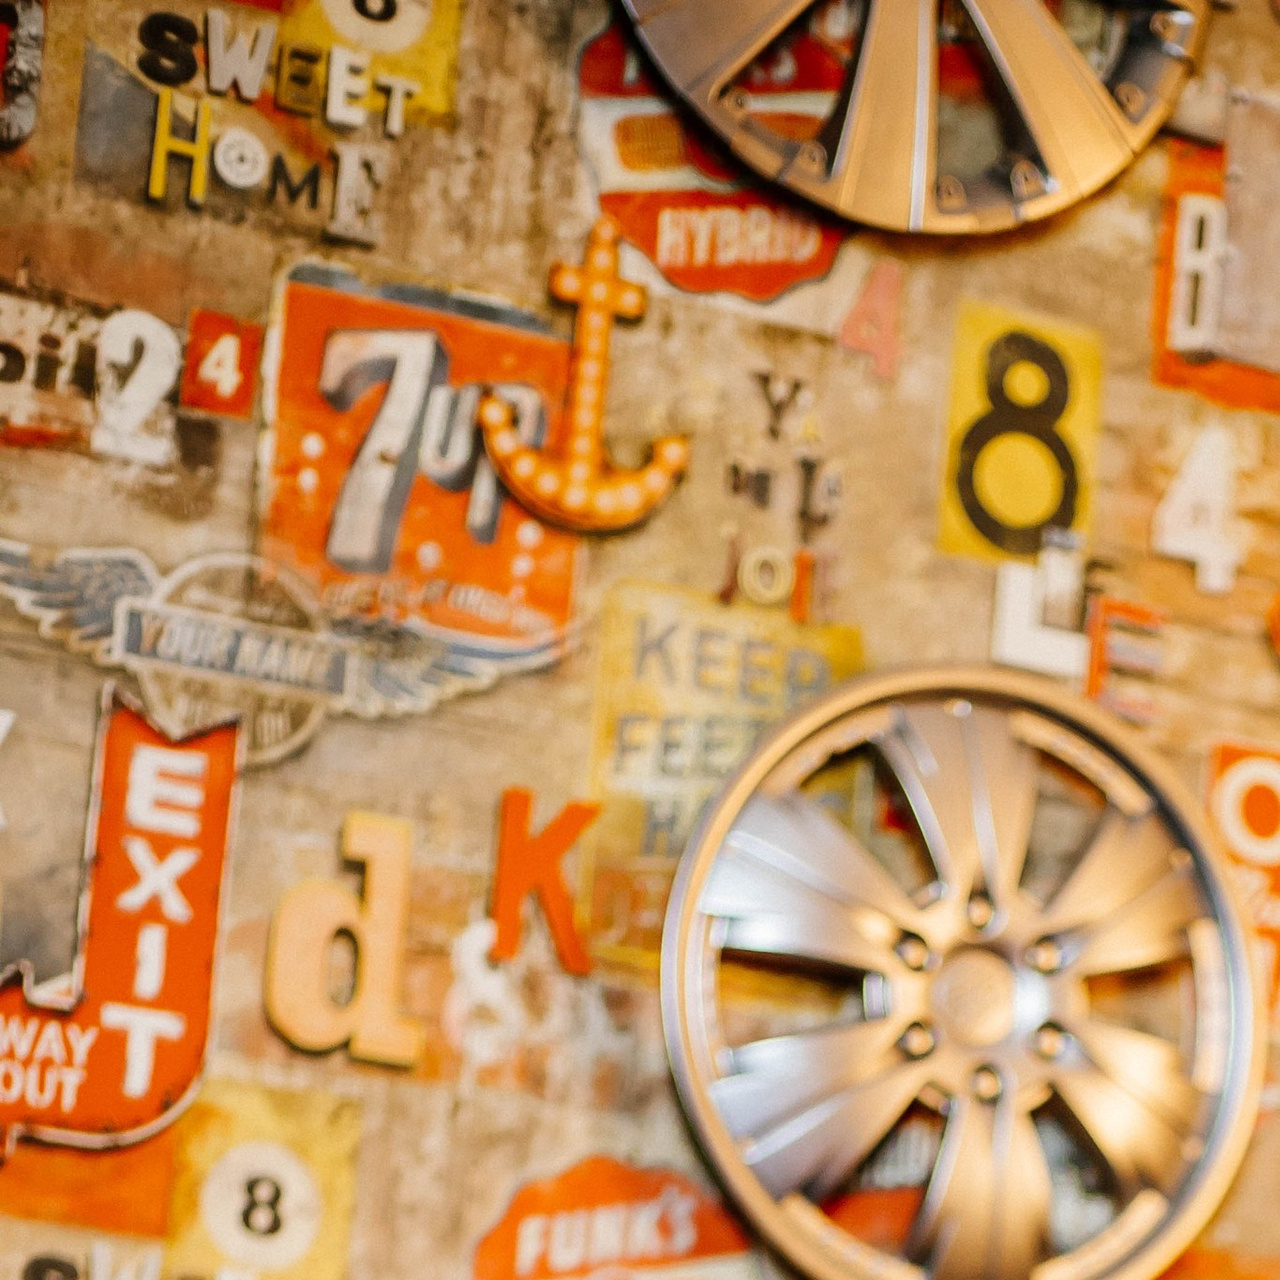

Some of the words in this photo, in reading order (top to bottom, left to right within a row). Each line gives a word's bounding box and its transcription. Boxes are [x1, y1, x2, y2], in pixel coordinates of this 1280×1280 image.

[137, 10, 421, 137] SWEET
[150, 88, 388, 248] HOME
[656, 204, 822, 270] HYBRID
[90, 308, 182, 466] 2
[198, 333, 244, 398] 4
[956, 332, 1078, 555] 8
[1155, 425, 1242, 592] 4
[100, 744, 210, 1101] EXIT
[265, 811, 426, 1068] d
[490, 786, 602, 978] K
[0, 1014, 97, 1062] WAY
[241, 1175, 282, 1238] 8
